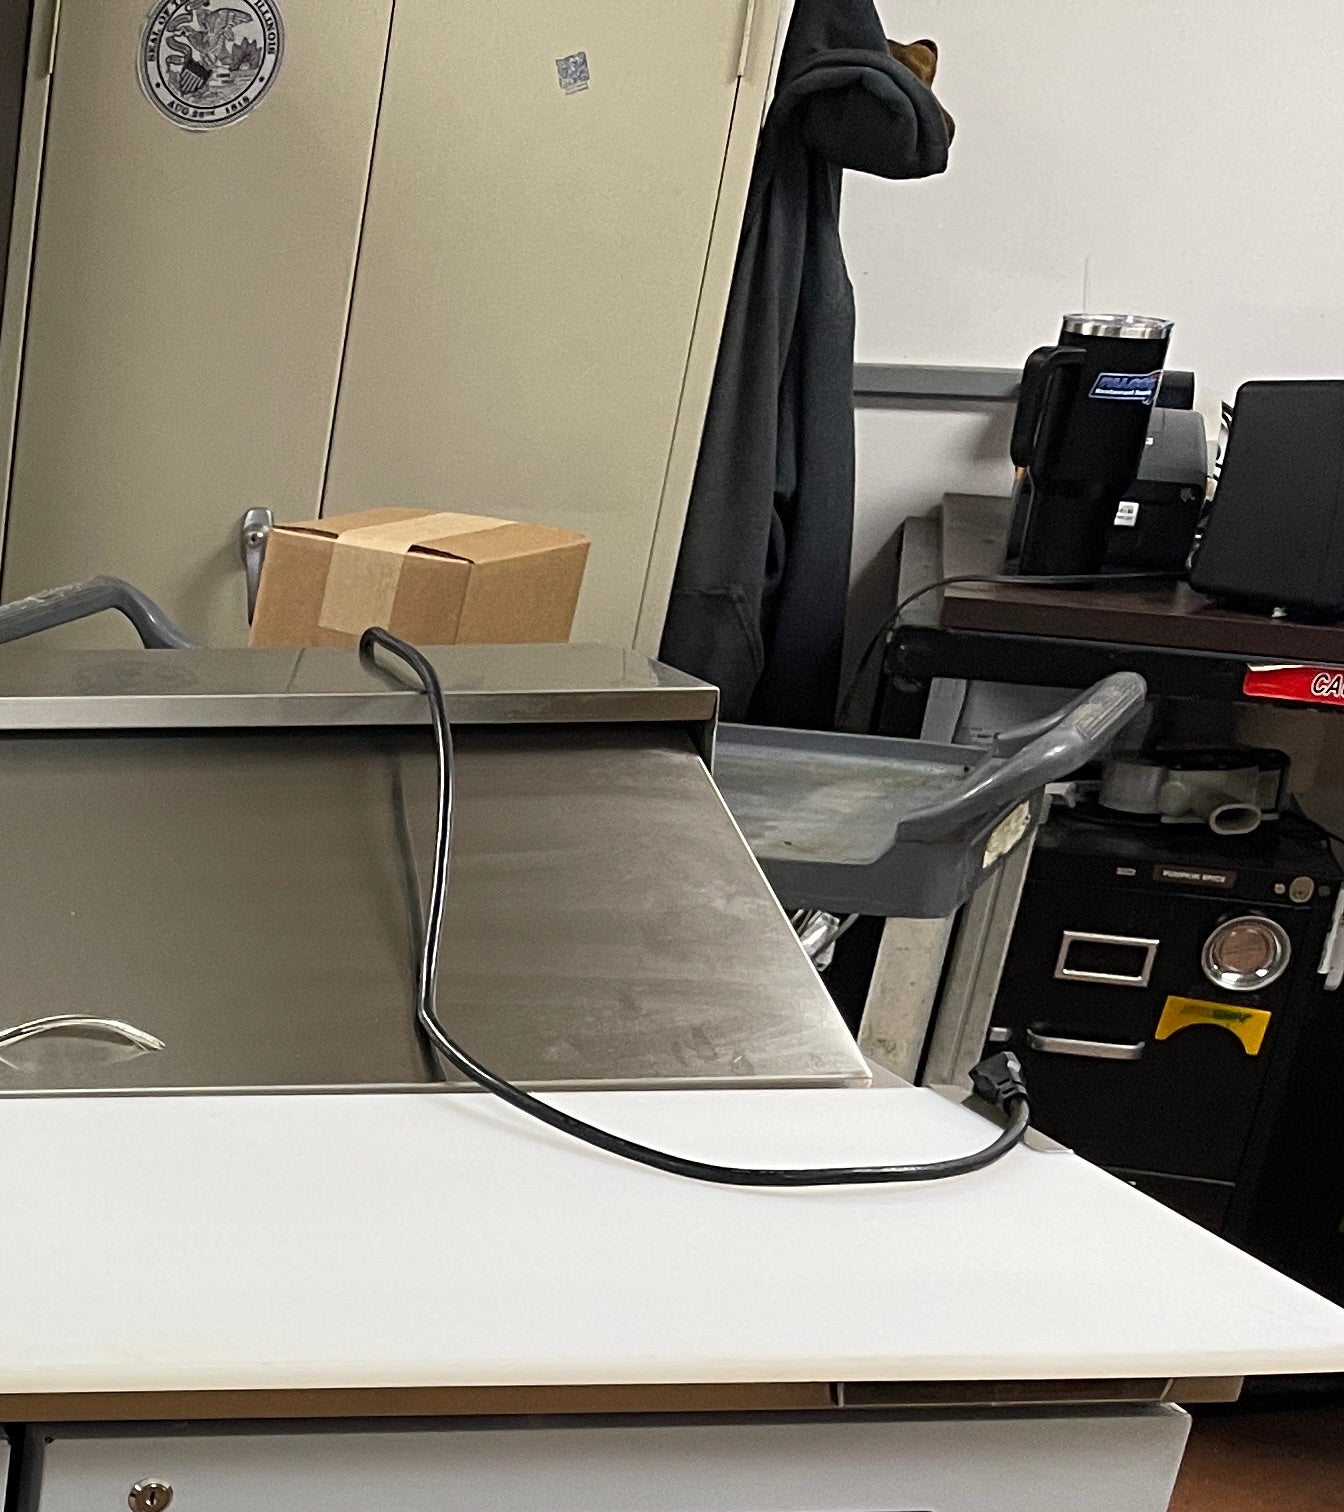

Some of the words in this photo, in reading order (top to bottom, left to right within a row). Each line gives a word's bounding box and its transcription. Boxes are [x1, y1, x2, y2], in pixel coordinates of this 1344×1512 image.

[147, 29, 162, 62] SEAL
[158, 8, 171, 25] OF
[1310, 671, 1344, 700] CA
